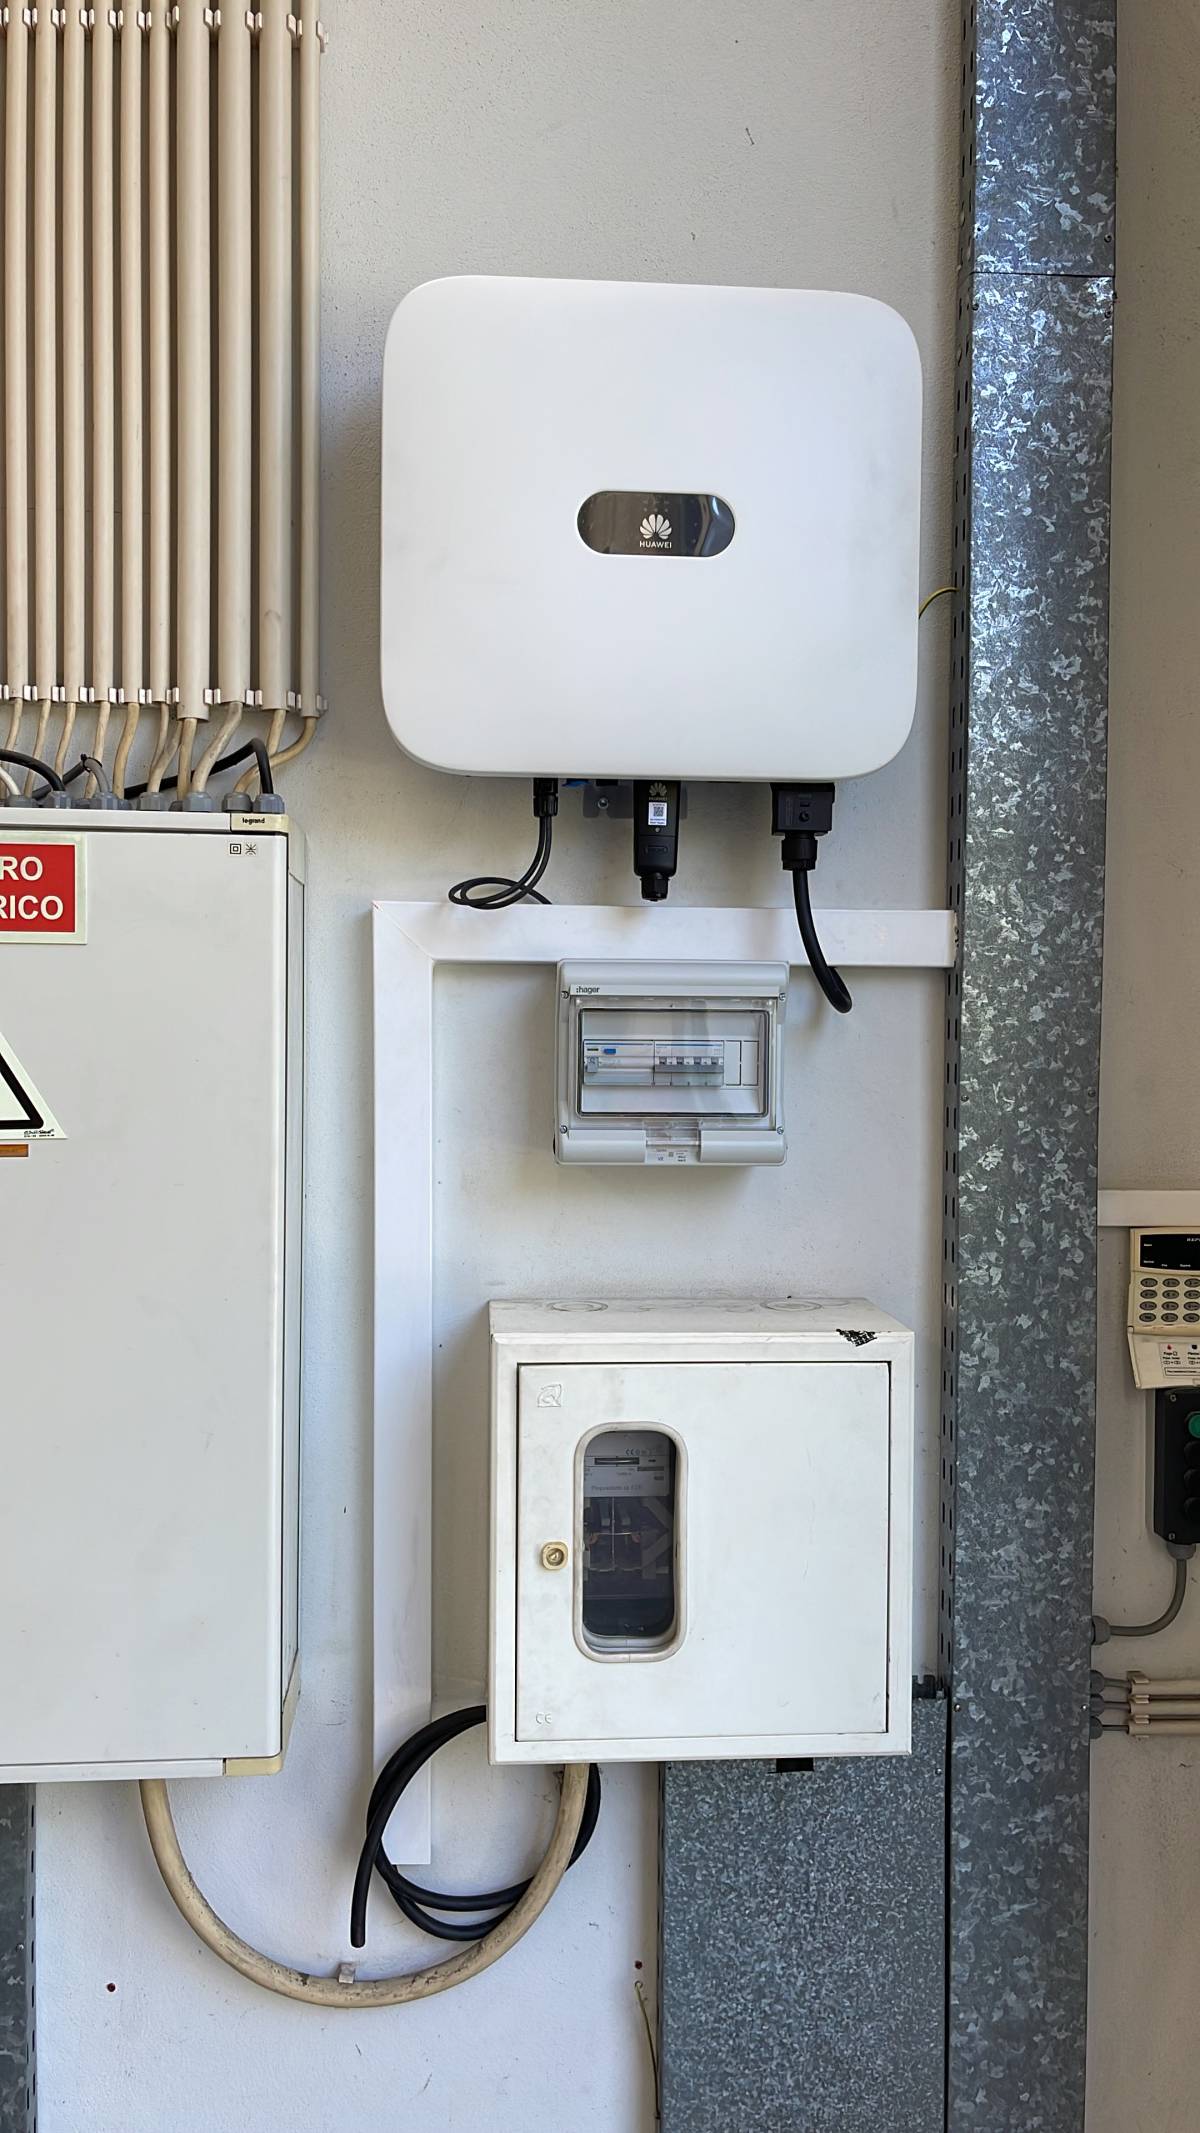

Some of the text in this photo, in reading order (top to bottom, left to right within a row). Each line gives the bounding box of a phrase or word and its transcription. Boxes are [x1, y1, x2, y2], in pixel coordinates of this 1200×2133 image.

[639, 541, 672, 549] HUAWEI
[242, 817, 266, 825] legrand
[0, 856, 43, 881] RO
